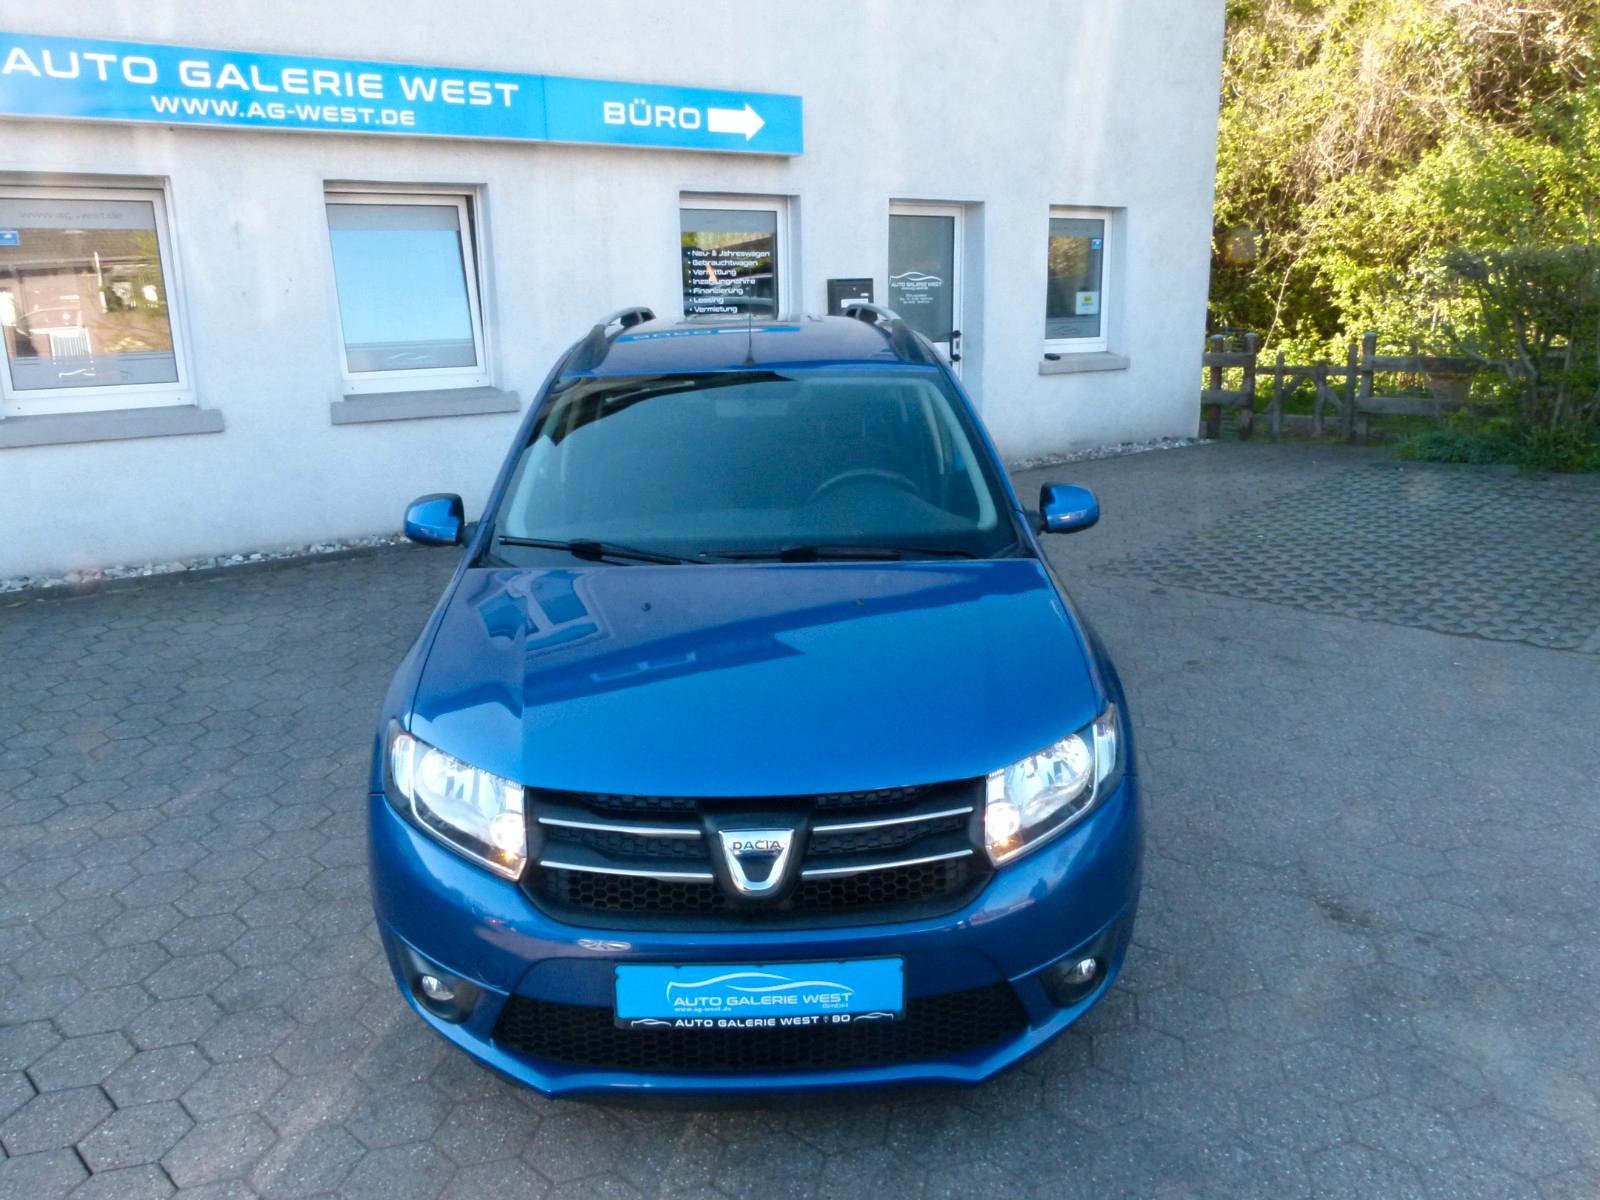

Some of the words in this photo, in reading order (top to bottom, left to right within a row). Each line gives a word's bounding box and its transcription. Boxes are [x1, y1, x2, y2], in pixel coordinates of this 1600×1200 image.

[2, 47, 158, 85] AUTO
[179, 60, 384, 99] GALERIE
[399, 75, 519, 107] WEST
[151, 96, 416, 127] WWW.AG-WEST.DE
[603, 99, 700, 129] BÜRO
[719, 250, 770, 259] Jahreswagen
[692, 259, 758, 267] Gebrauchtwagen
[692, 269, 737, 277] Verttlung
[693, 287, 744, 295] Finanzierung
[733, 840, 781, 850] DACIA
[673, 996, 722, 1007] AUTO
[726, 995, 798, 1006] GALERIE
[802, 992, 853, 1003] WEST
[675, 1019, 714, 1028] AUTO
[718, 1018, 776, 1028] GALERIE
[780, 1016, 820, 1026] WEST
